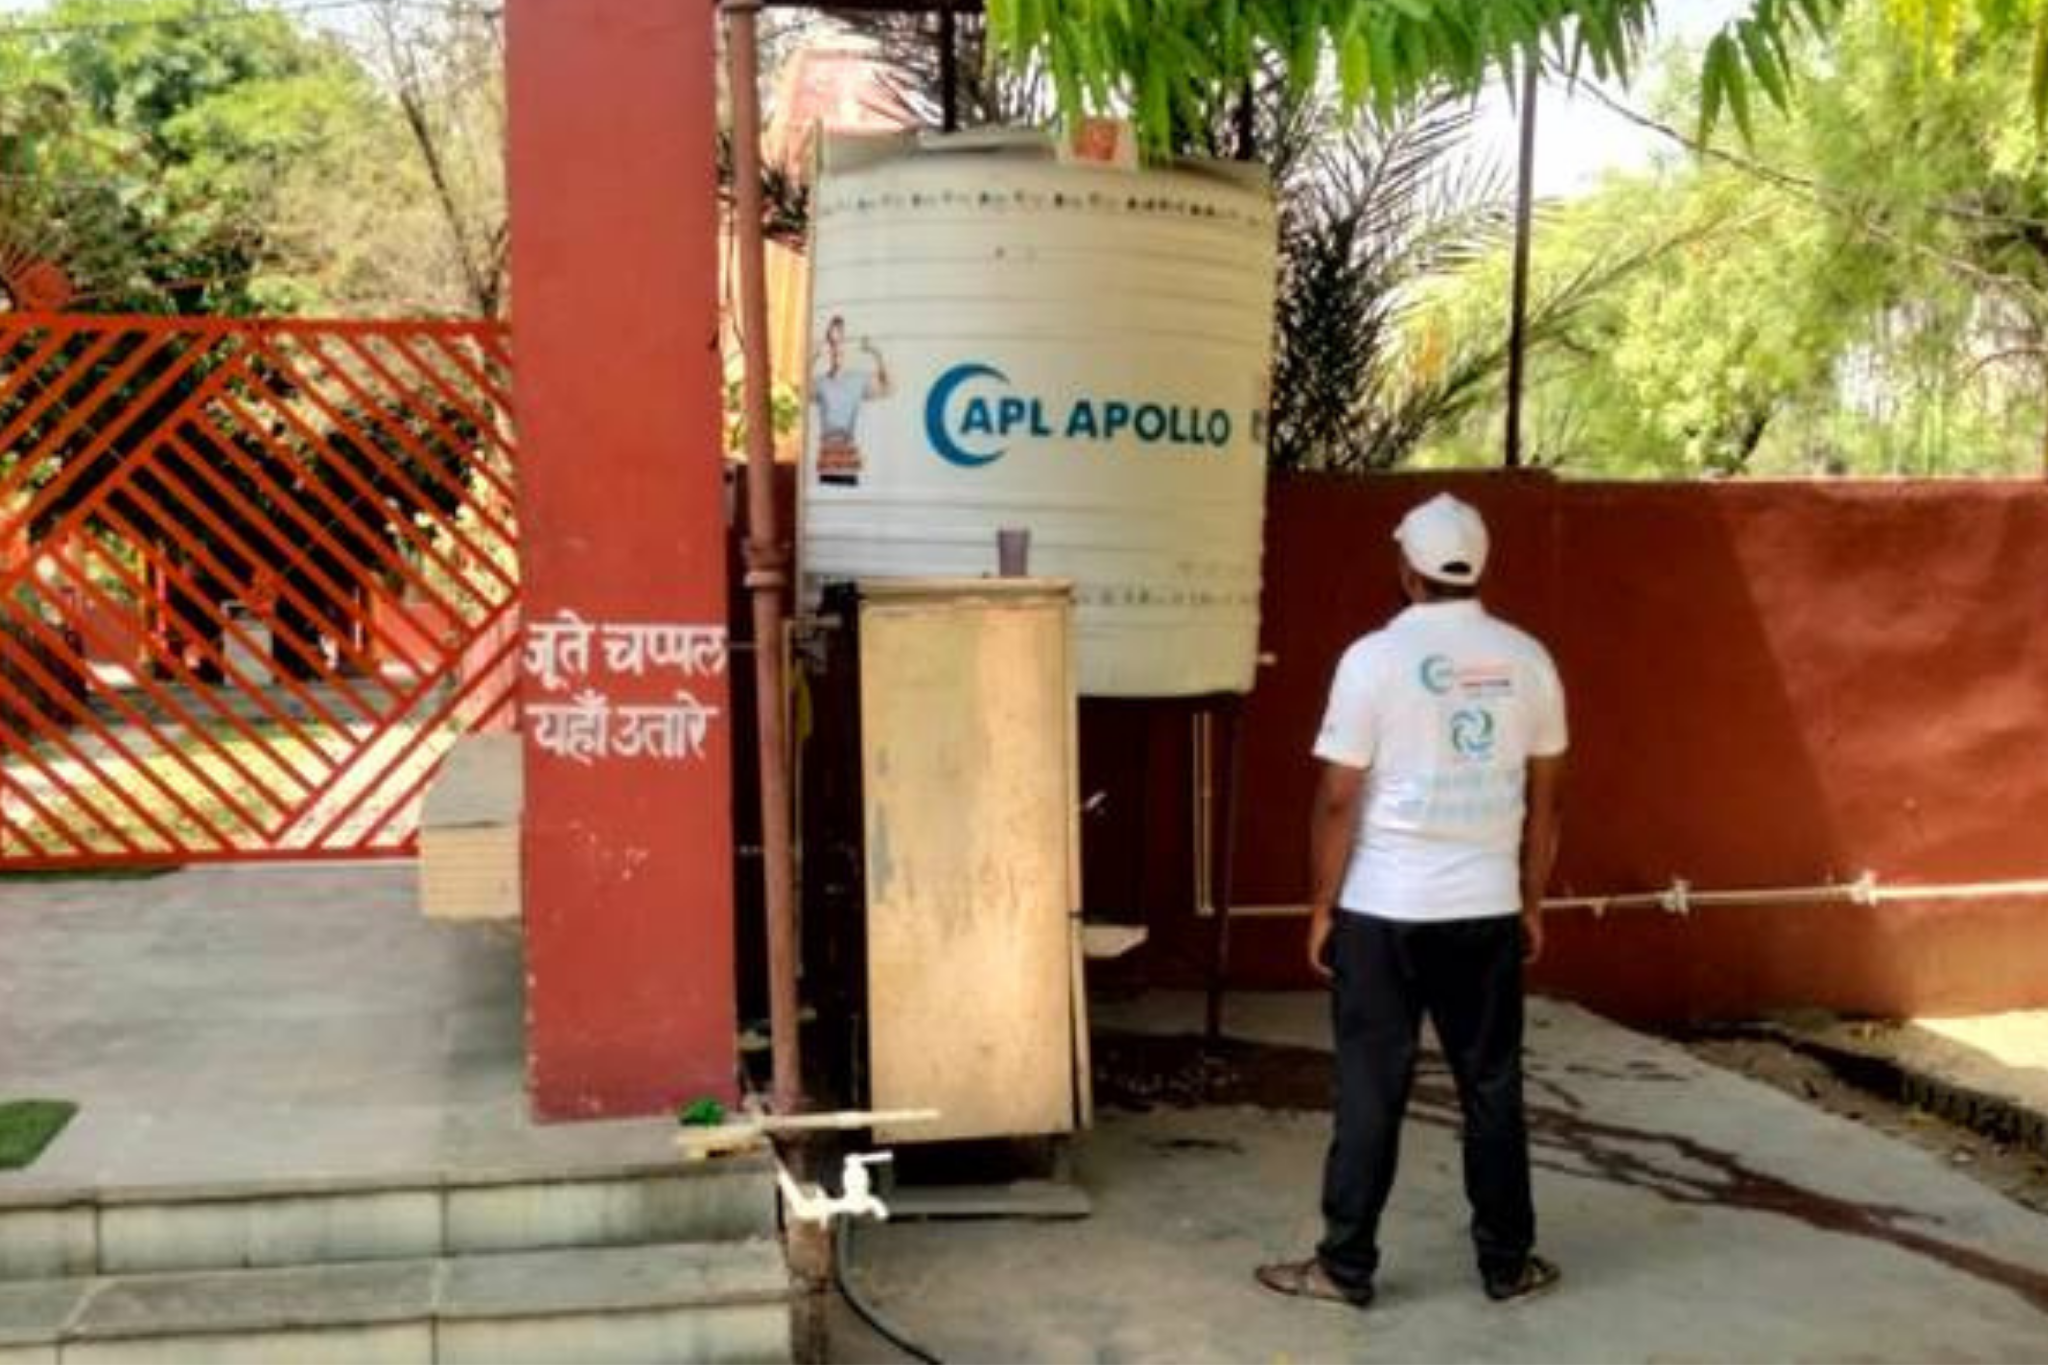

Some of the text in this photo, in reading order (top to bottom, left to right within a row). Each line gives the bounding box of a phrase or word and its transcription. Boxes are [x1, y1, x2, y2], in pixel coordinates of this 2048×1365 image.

[960, 397, 1052, 437] APL
[1065, 398, 1231, 447] APOLLO
[523, 608, 727, 691] जूते चप्पल
[525, 688, 719, 766] यहाँ उतारे
